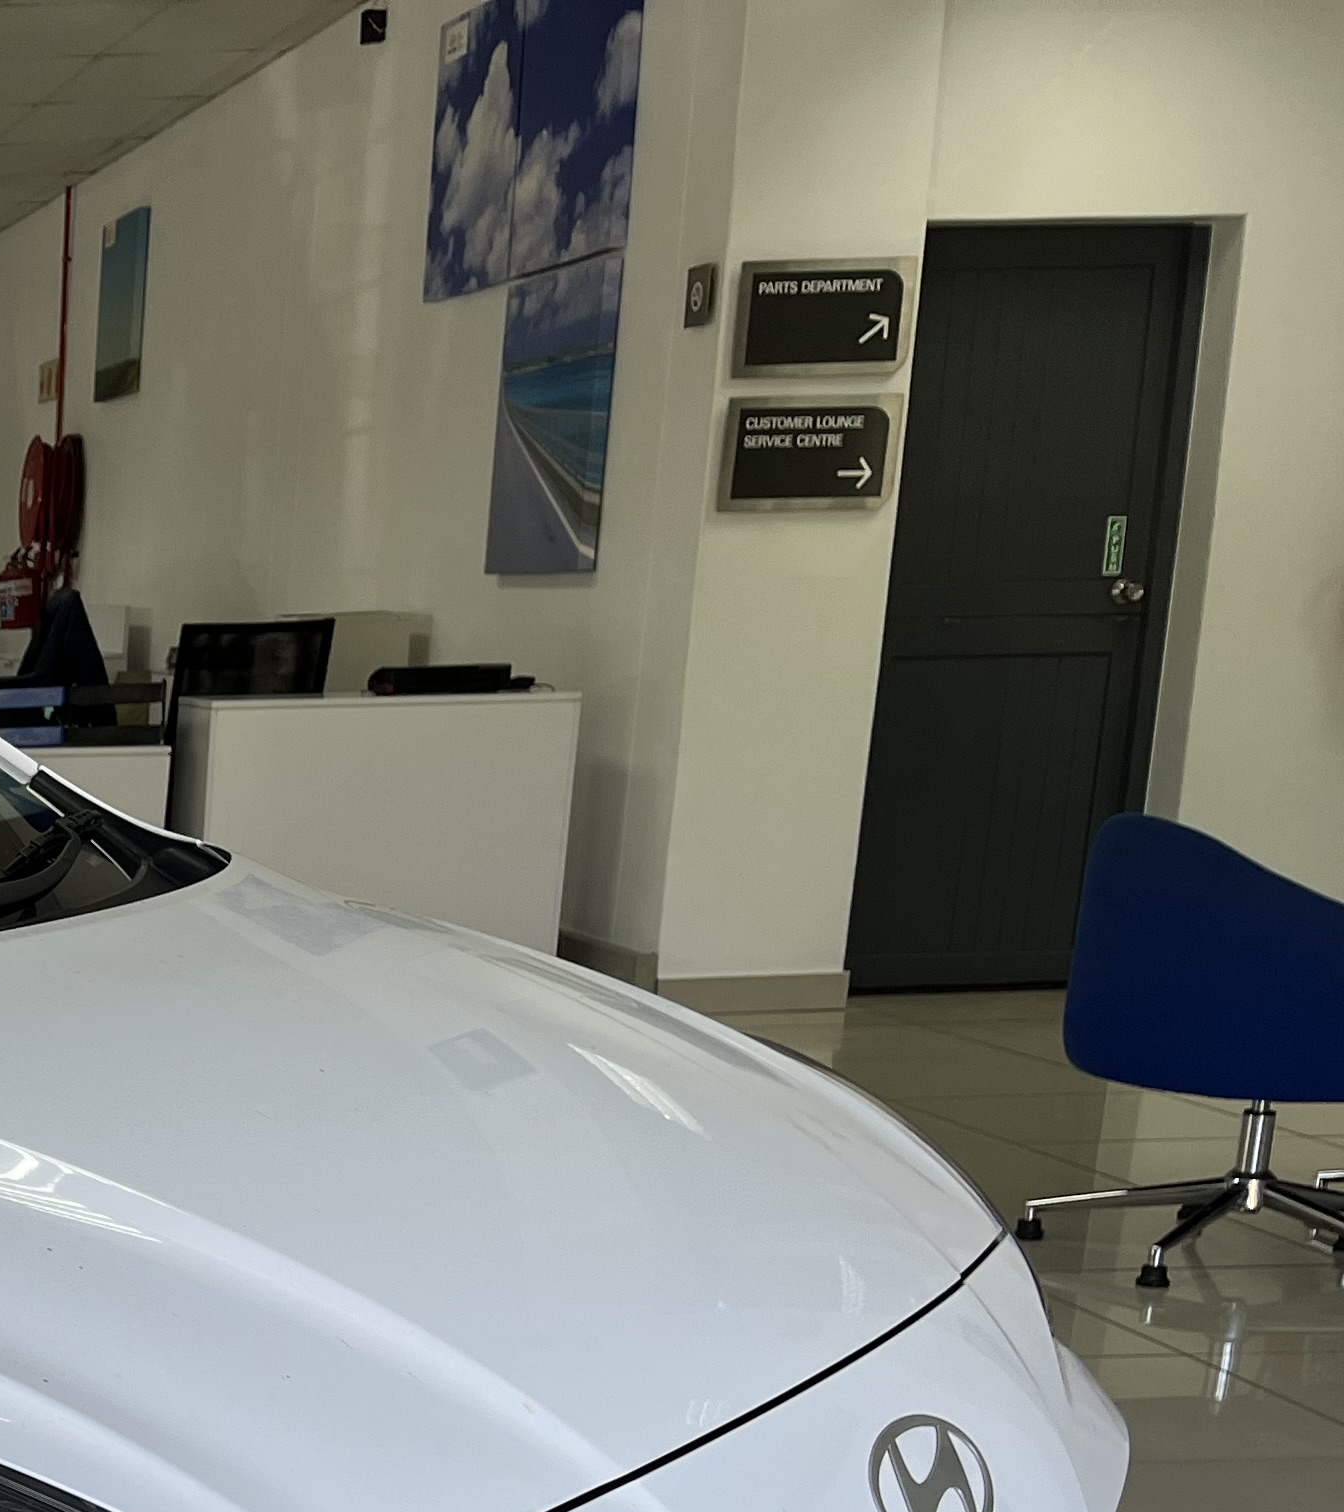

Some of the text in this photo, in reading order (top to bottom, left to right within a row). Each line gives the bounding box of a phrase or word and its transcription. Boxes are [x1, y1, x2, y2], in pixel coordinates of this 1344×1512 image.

[758, 278, 883, 295] PARTS DEPARTMENT
[745, 414, 864, 430] CUSTOMER LOUNGE
[743, 433, 843, 448] SERVICE CENTRE
